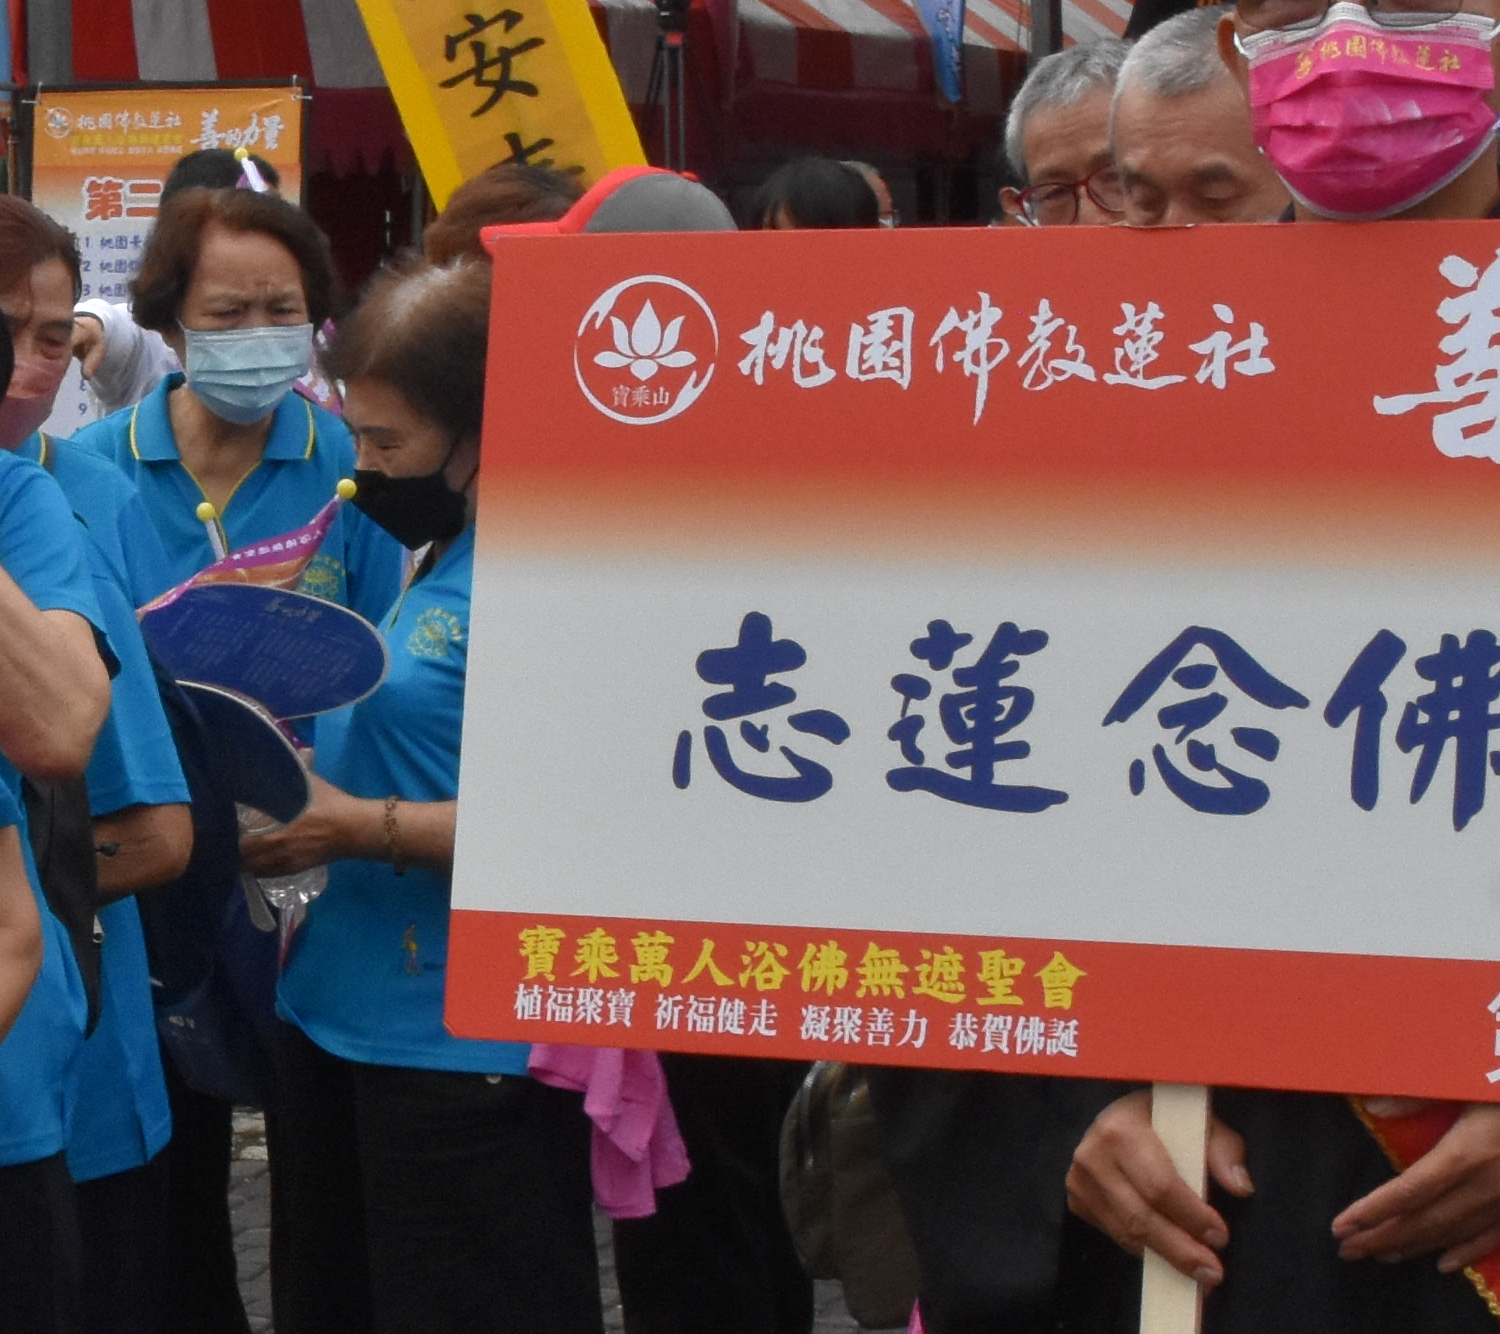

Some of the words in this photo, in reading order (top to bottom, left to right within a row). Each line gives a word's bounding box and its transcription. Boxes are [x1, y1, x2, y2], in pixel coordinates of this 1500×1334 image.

[190, 108, 285, 150] 善的力量
[738, 292, 1276, 424] 桃園佛教蓮社
[611, 384, 671, 408] 寶乘山
[518, 924, 1087, 1010] 寶乘萬人浴佛無遮聖會
[513, 984, 636, 1028] 植福聚寶
[654, 994, 779, 1037] 祈福健走
[799, 1006, 929, 1049] 凝聚善力
[949, 1013, 1080, 1058] 恭賀佛誕
